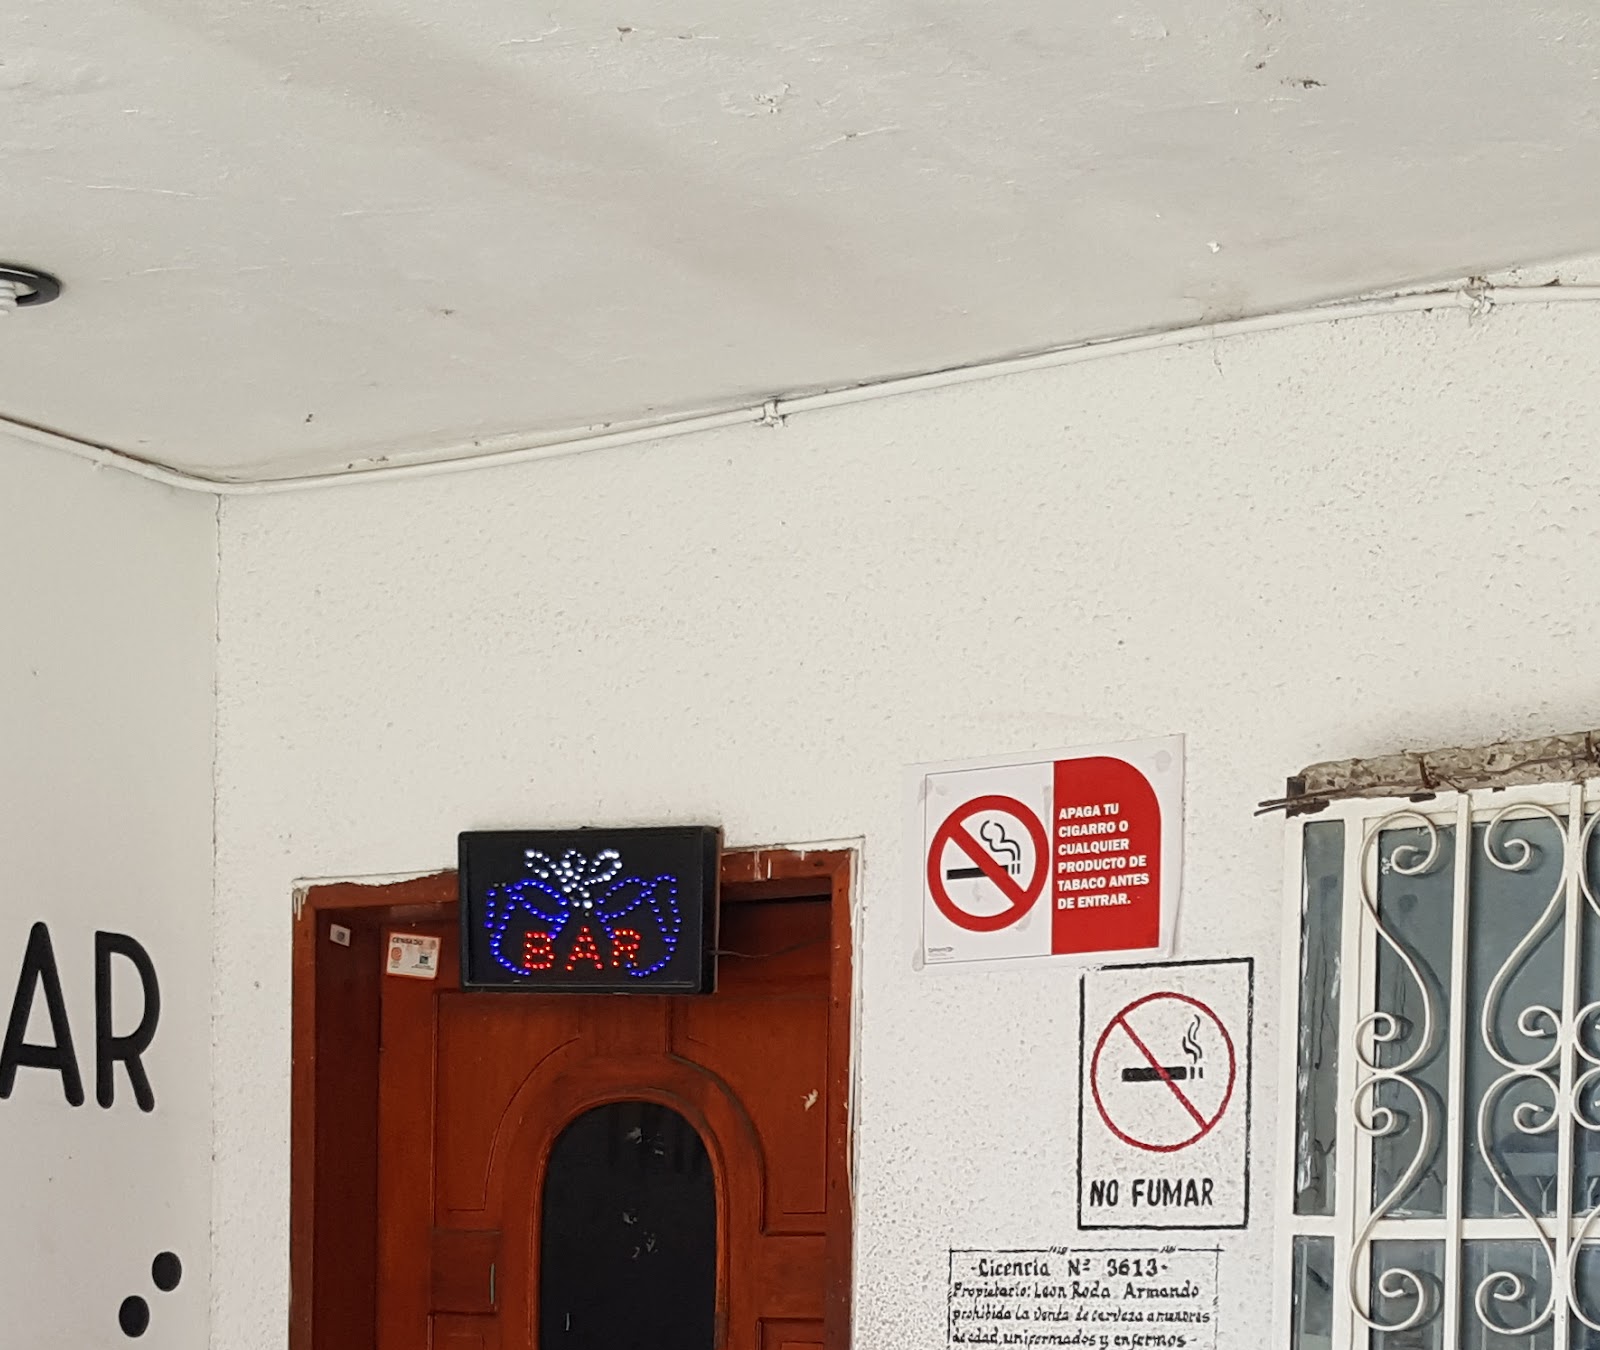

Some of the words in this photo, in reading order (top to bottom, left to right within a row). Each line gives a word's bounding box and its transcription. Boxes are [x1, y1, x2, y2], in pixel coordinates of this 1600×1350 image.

[1059, 804, 1101, 820] APAGA
[1103, 802, 1119, 816] TU
[1058, 821, 1116, 838] CIGARRO
[1118, 820, 1129, 832] O
[1058, 838, 1129, 856] CUALQUIER
[1057, 856, 1126, 873] PRODUCTO
[1128, 854, 1147, 868] DE
[1057, 876, 1106, 892] TABACO
[1108, 873, 1150, 888] ANTES
[1057, 897, 1075, 910] DE
[1077, 893, 1131, 908] ENTRAR.
[522, 926, 642, 971] BAR
[1090, 1179, 1119, 1207] NO
[1132, 1178, 1214, 1207] FUMAR
